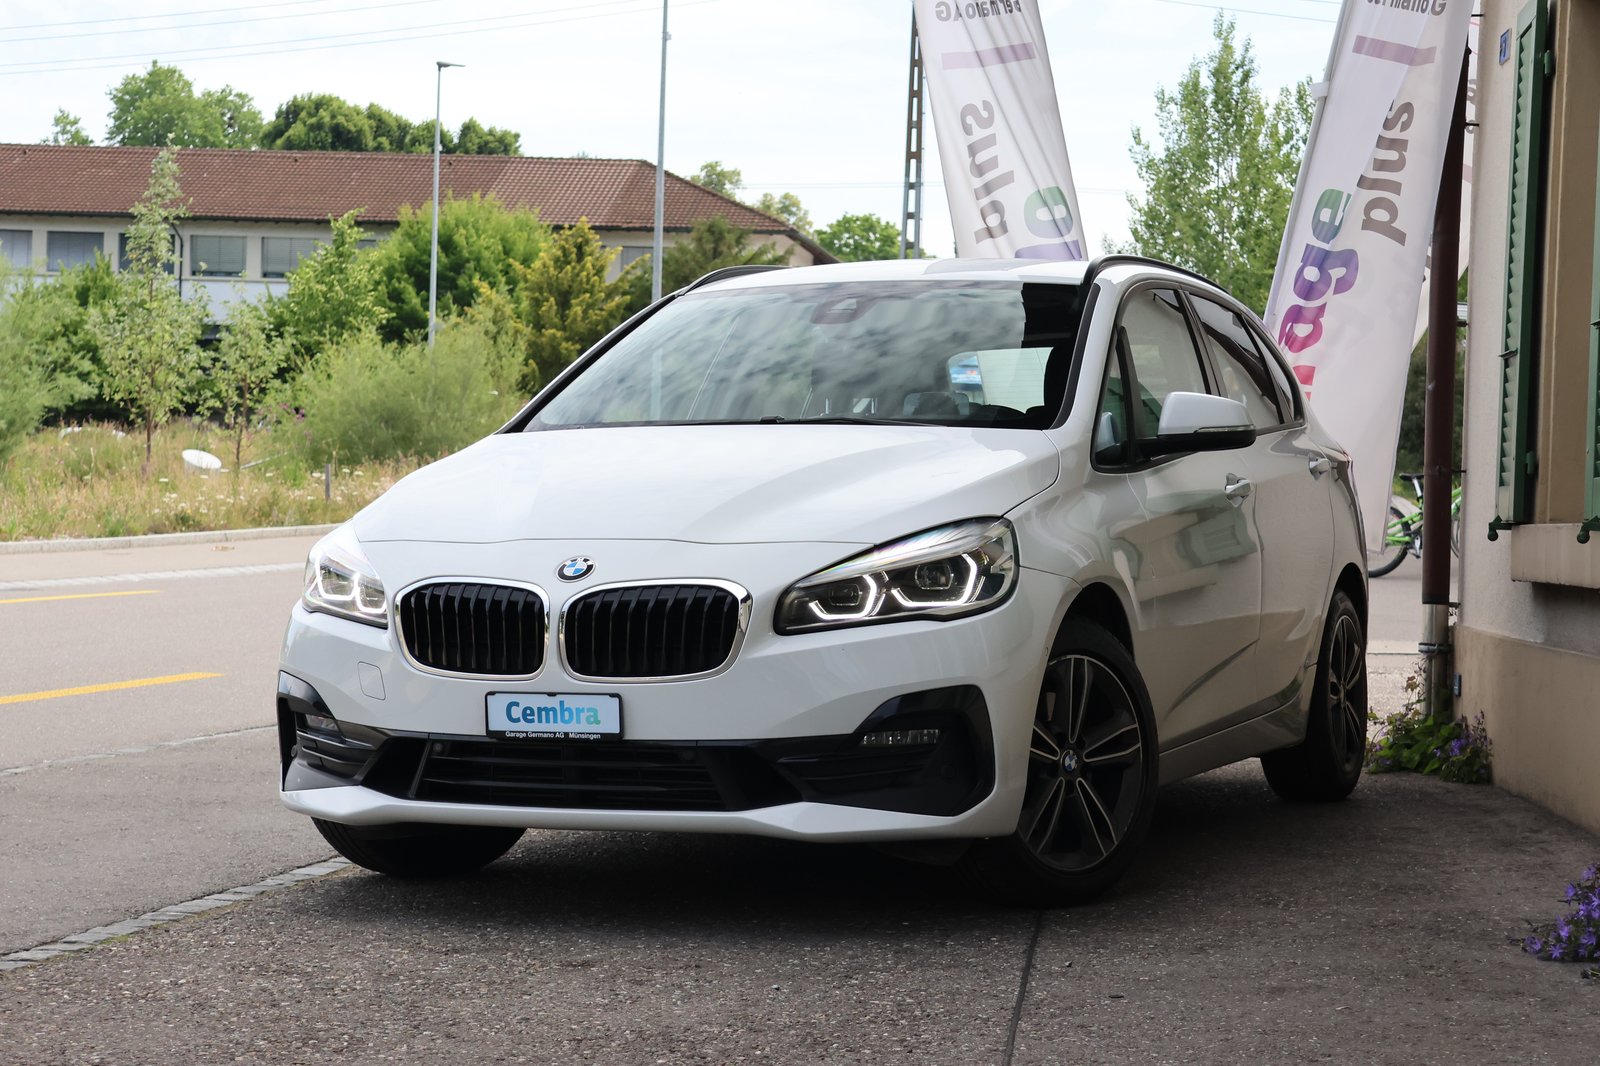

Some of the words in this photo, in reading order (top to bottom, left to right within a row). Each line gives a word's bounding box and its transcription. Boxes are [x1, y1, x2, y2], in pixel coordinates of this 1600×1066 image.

[1356, 99, 1415, 247] plus
[505, 700, 601, 725] Cembra
[568, 732, 602, 740] Münsingen
